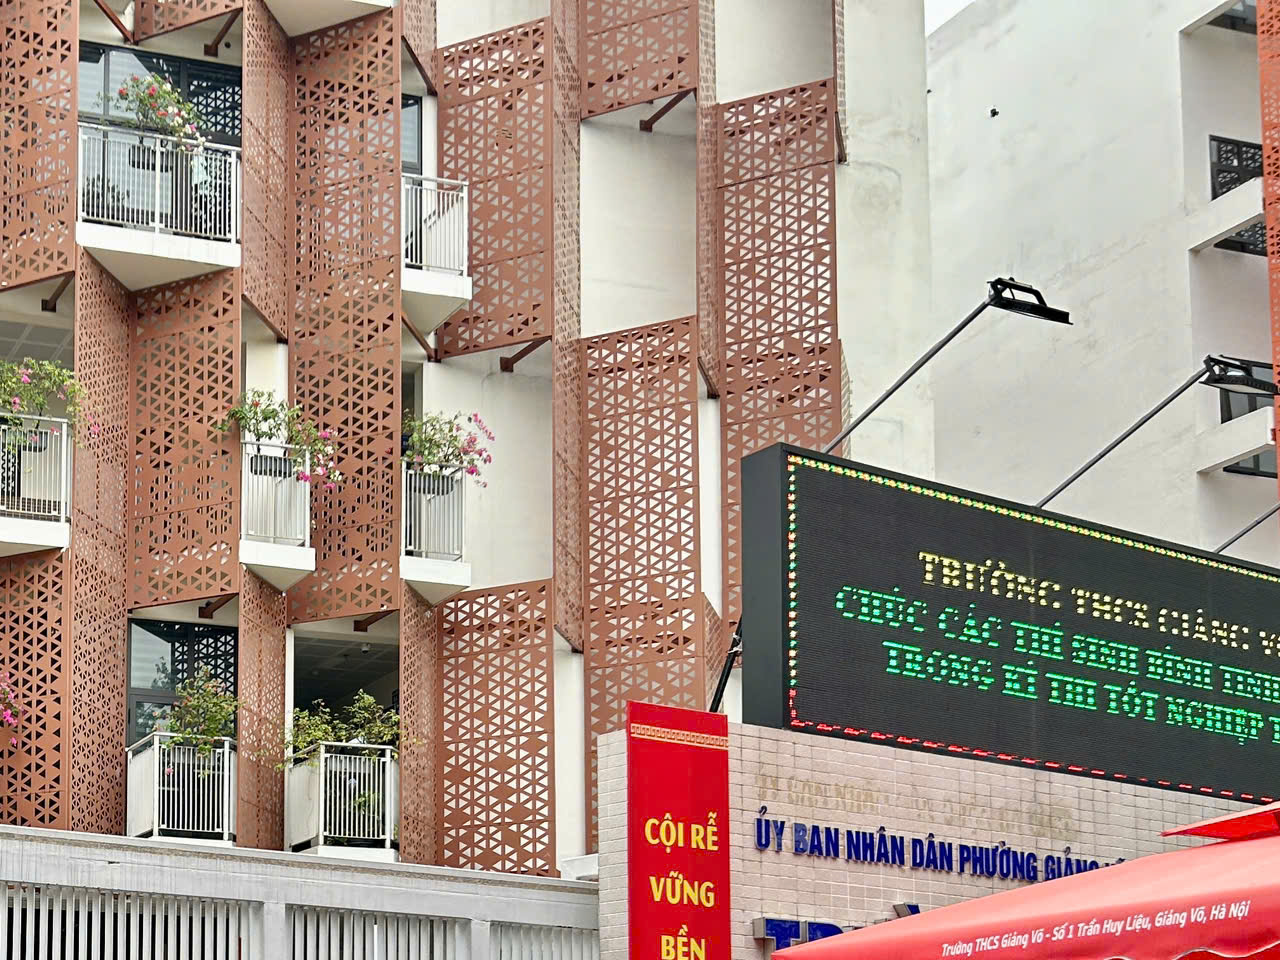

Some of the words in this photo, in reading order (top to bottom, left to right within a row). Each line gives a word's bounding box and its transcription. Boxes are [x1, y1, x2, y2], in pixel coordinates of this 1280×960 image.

[835, 585, 928, 632] CHÚC
[938, 602, 1002, 647] CÁC
[1071, 634, 1140, 675] SINH
[1070, 587, 1150, 628] THCS
[882, 640, 995, 690] TRONG
[1044, 672, 1097, 710] THI
[1103, 680, 1160, 721] TỐT
[1165, 695, 1265, 746] NGHIỆP
[644, 812, 684, 853] CỘI
[691, 811, 719, 852] RỄ
[754, 805, 785, 851] ỦY
[793, 822, 839, 859] BAN
[845, 826, 905, 866] NHÂN
[910, 832, 953, 873] DÂN
[958, 840, 1038, 882] PHƯỜNG
[649, 871, 715, 908] VỮNG
[941, 940, 973, 957] Trường
[975, 935, 999, 952] THCS
[1001, 931, 1029, 949] Giảng
[1031, 928, 1045, 943] Võ
[1051, 922, 1068, 941] Số
[1068, 925, 1074, 938] 1
[1077, 918, 1100, 937] Trần
[1102, 919, 1124, 936] Huy
[1125, 913, 1152, 932] Liệu,
[1190, 906, 1207, 923] Võ,
[1209, 903, 1227, 920] Hà
[1228, 900, 1251, 921] Nội
